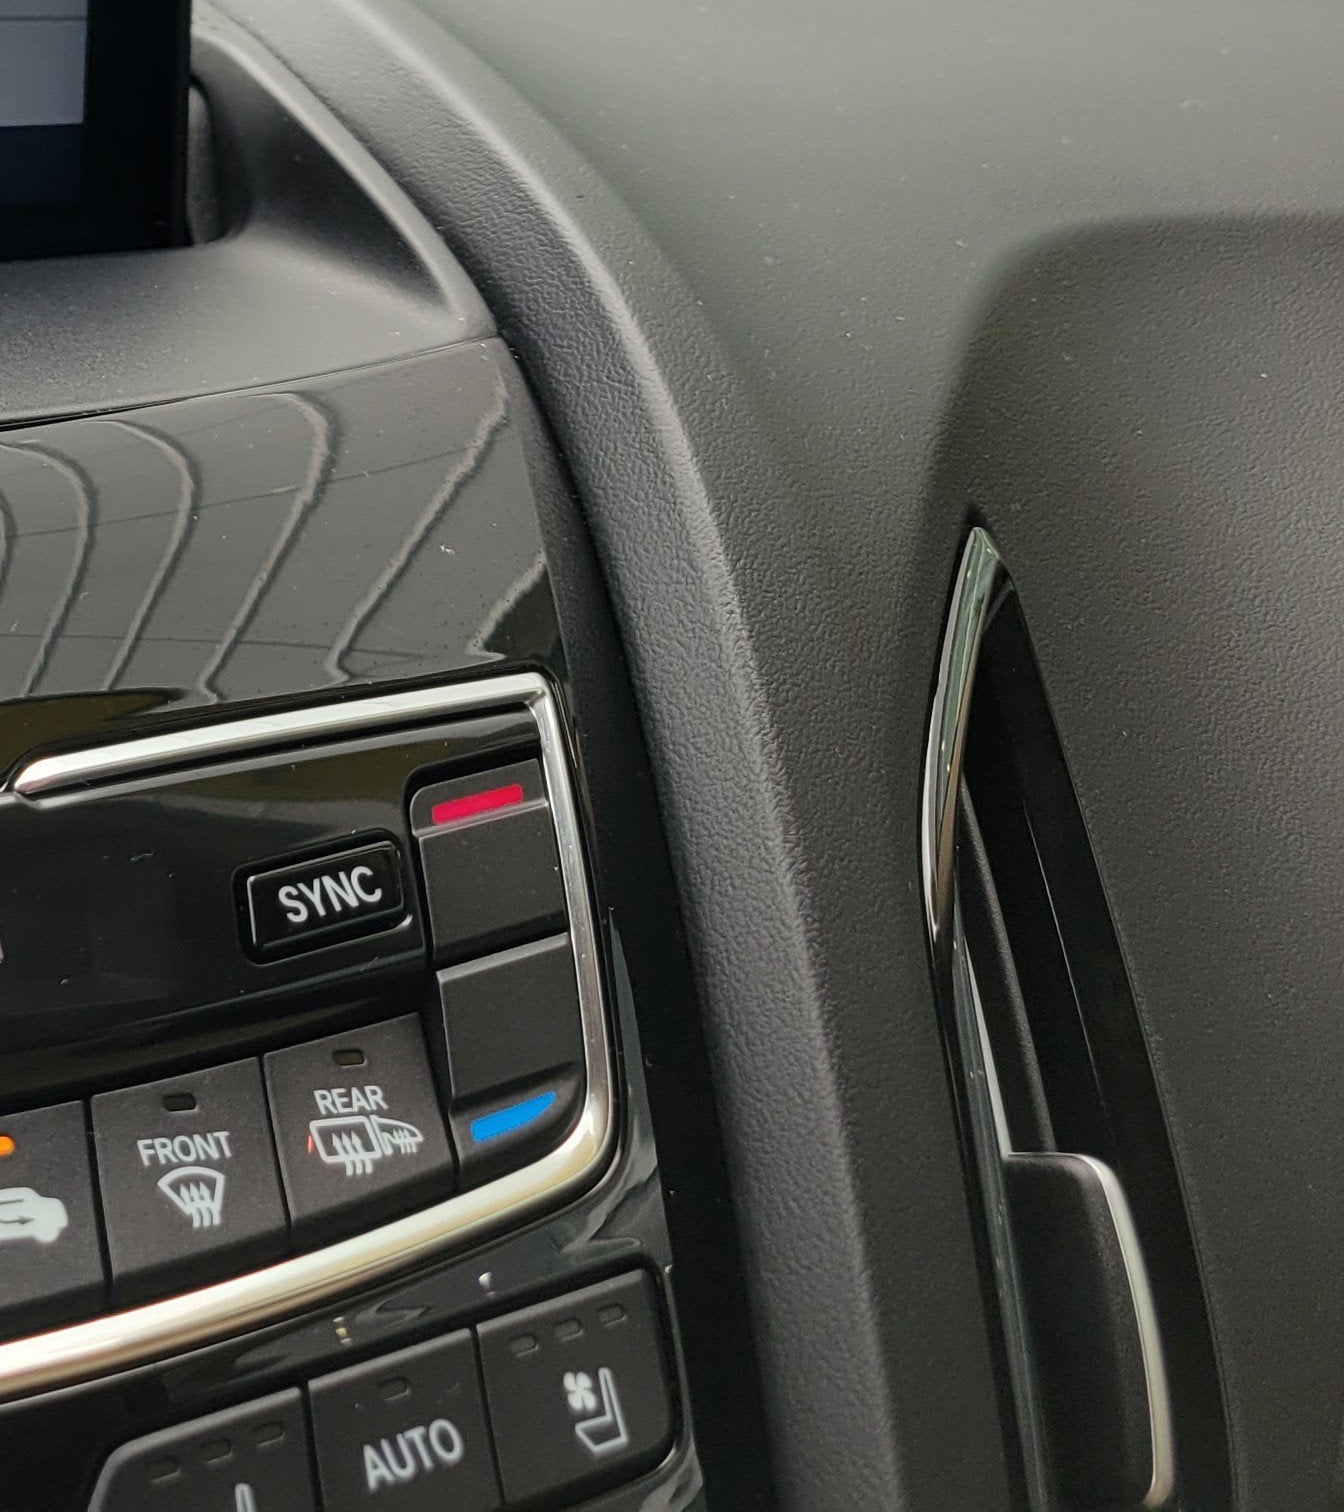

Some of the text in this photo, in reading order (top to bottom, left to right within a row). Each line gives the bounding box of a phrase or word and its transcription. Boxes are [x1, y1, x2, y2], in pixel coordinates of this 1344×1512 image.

[278, 866, 382, 923] SYNC
[313, 1085, 388, 1114] REAR
[136, 1130, 232, 1167] FRONT
[362, 1418, 464, 1490] AUTO
